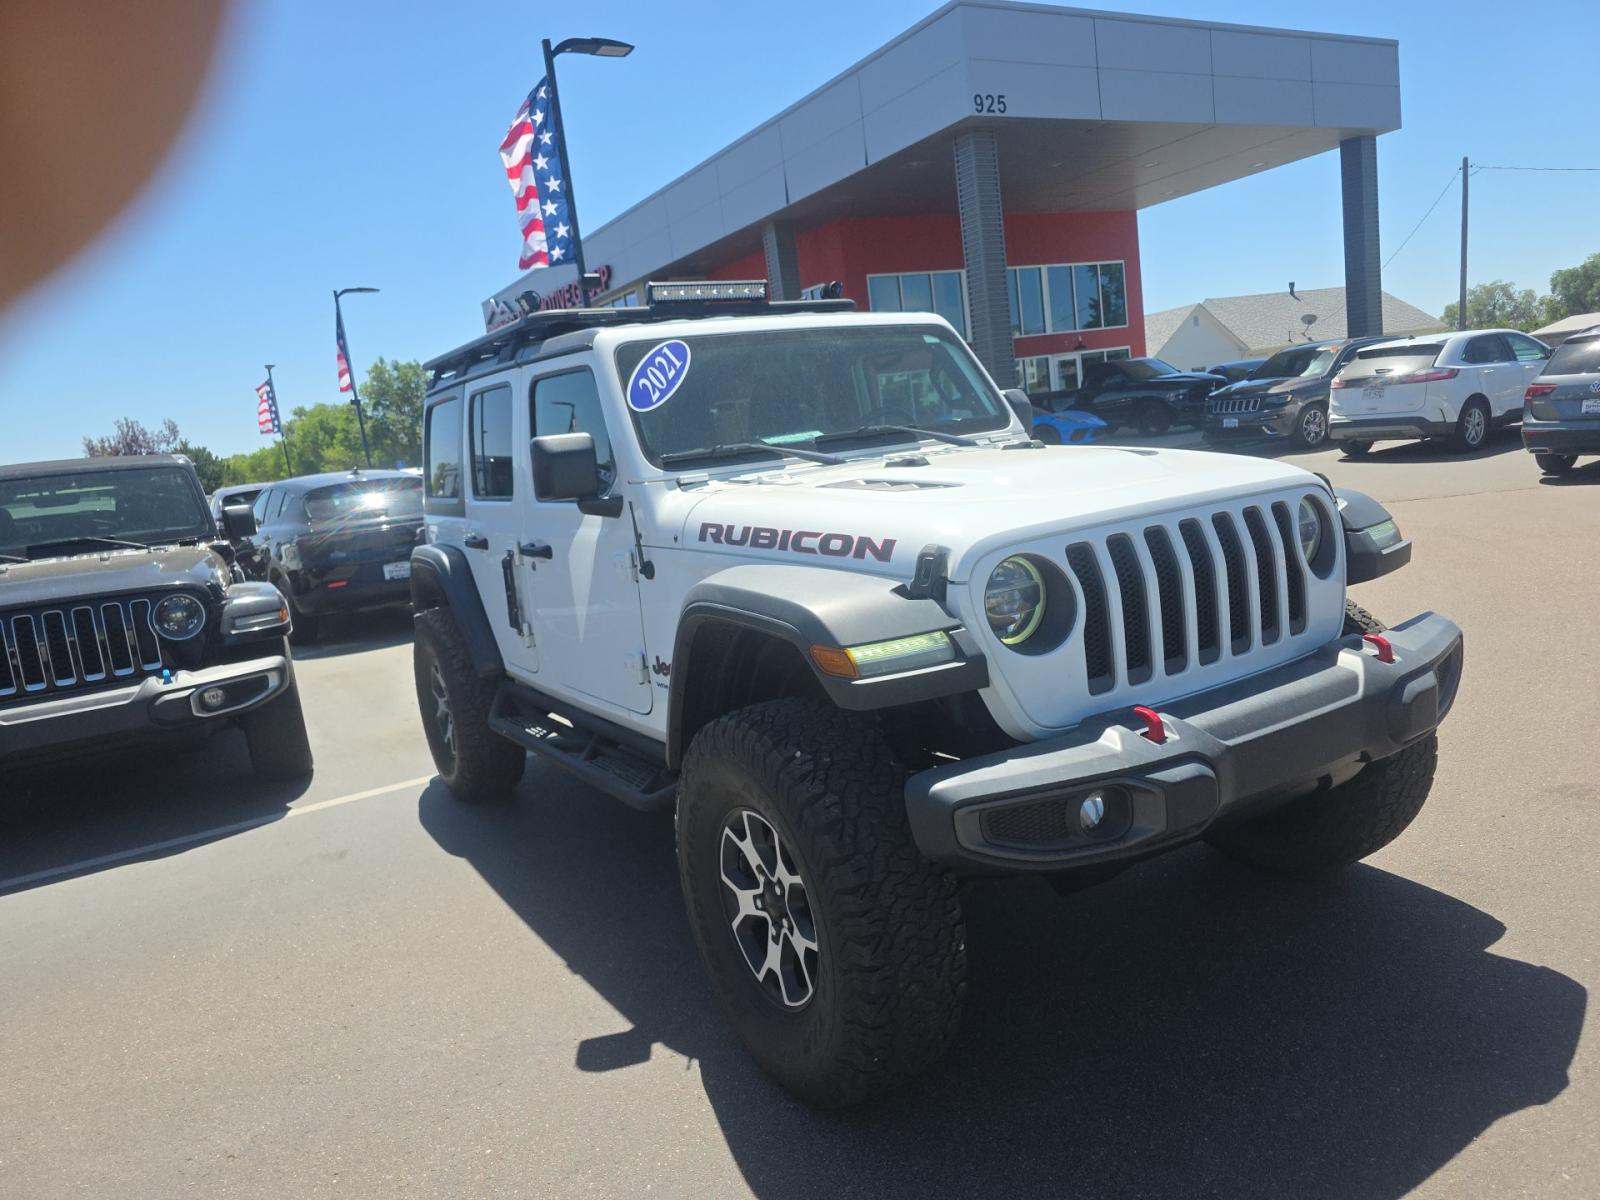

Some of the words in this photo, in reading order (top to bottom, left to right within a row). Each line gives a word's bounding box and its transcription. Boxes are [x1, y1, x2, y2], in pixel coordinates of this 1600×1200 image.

[974, 94, 1007, 113] 925
[638, 346, 683, 403] 2021
[698, 522, 897, 562] RUBICON
